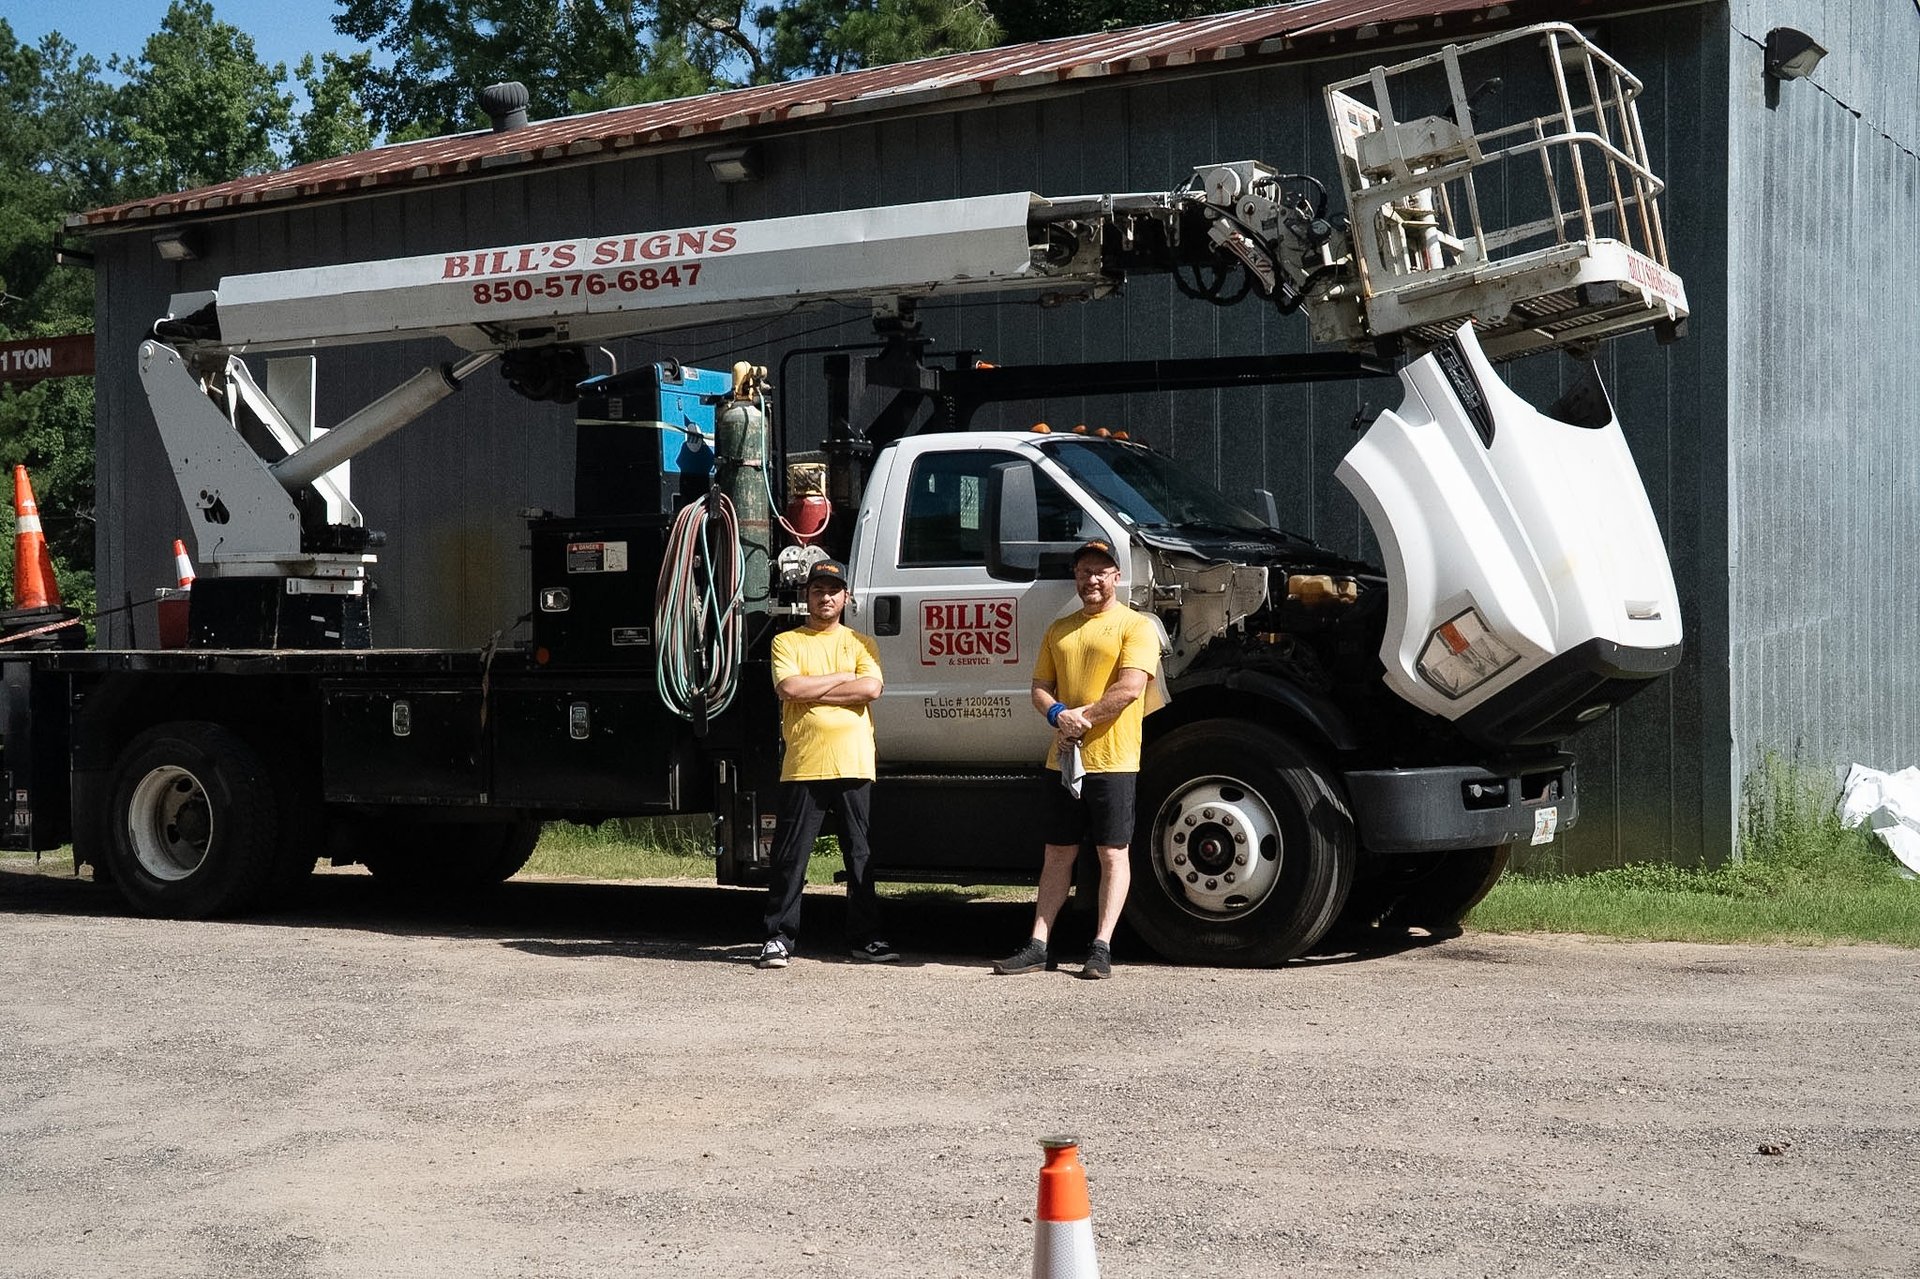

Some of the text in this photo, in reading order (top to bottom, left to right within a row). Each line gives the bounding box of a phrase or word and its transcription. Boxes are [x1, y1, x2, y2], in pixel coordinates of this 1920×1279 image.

[441, 227, 737, 279] BILL'S SIGNS
[473, 264, 702, 304] 850-576-6847
[0, 348, 52, 371] 1 TON
[925, 603, 1013, 630] BILL'S
[928, 631, 1011, 656] SIGNS
[948, 657, 991, 666] & SERVICE
[924, 698, 937, 707] FL
[938, 697, 954, 707] Lic
[966, 696, 1011, 707] 12002415
[925, 708, 1012, 719] USDOT#4344731
